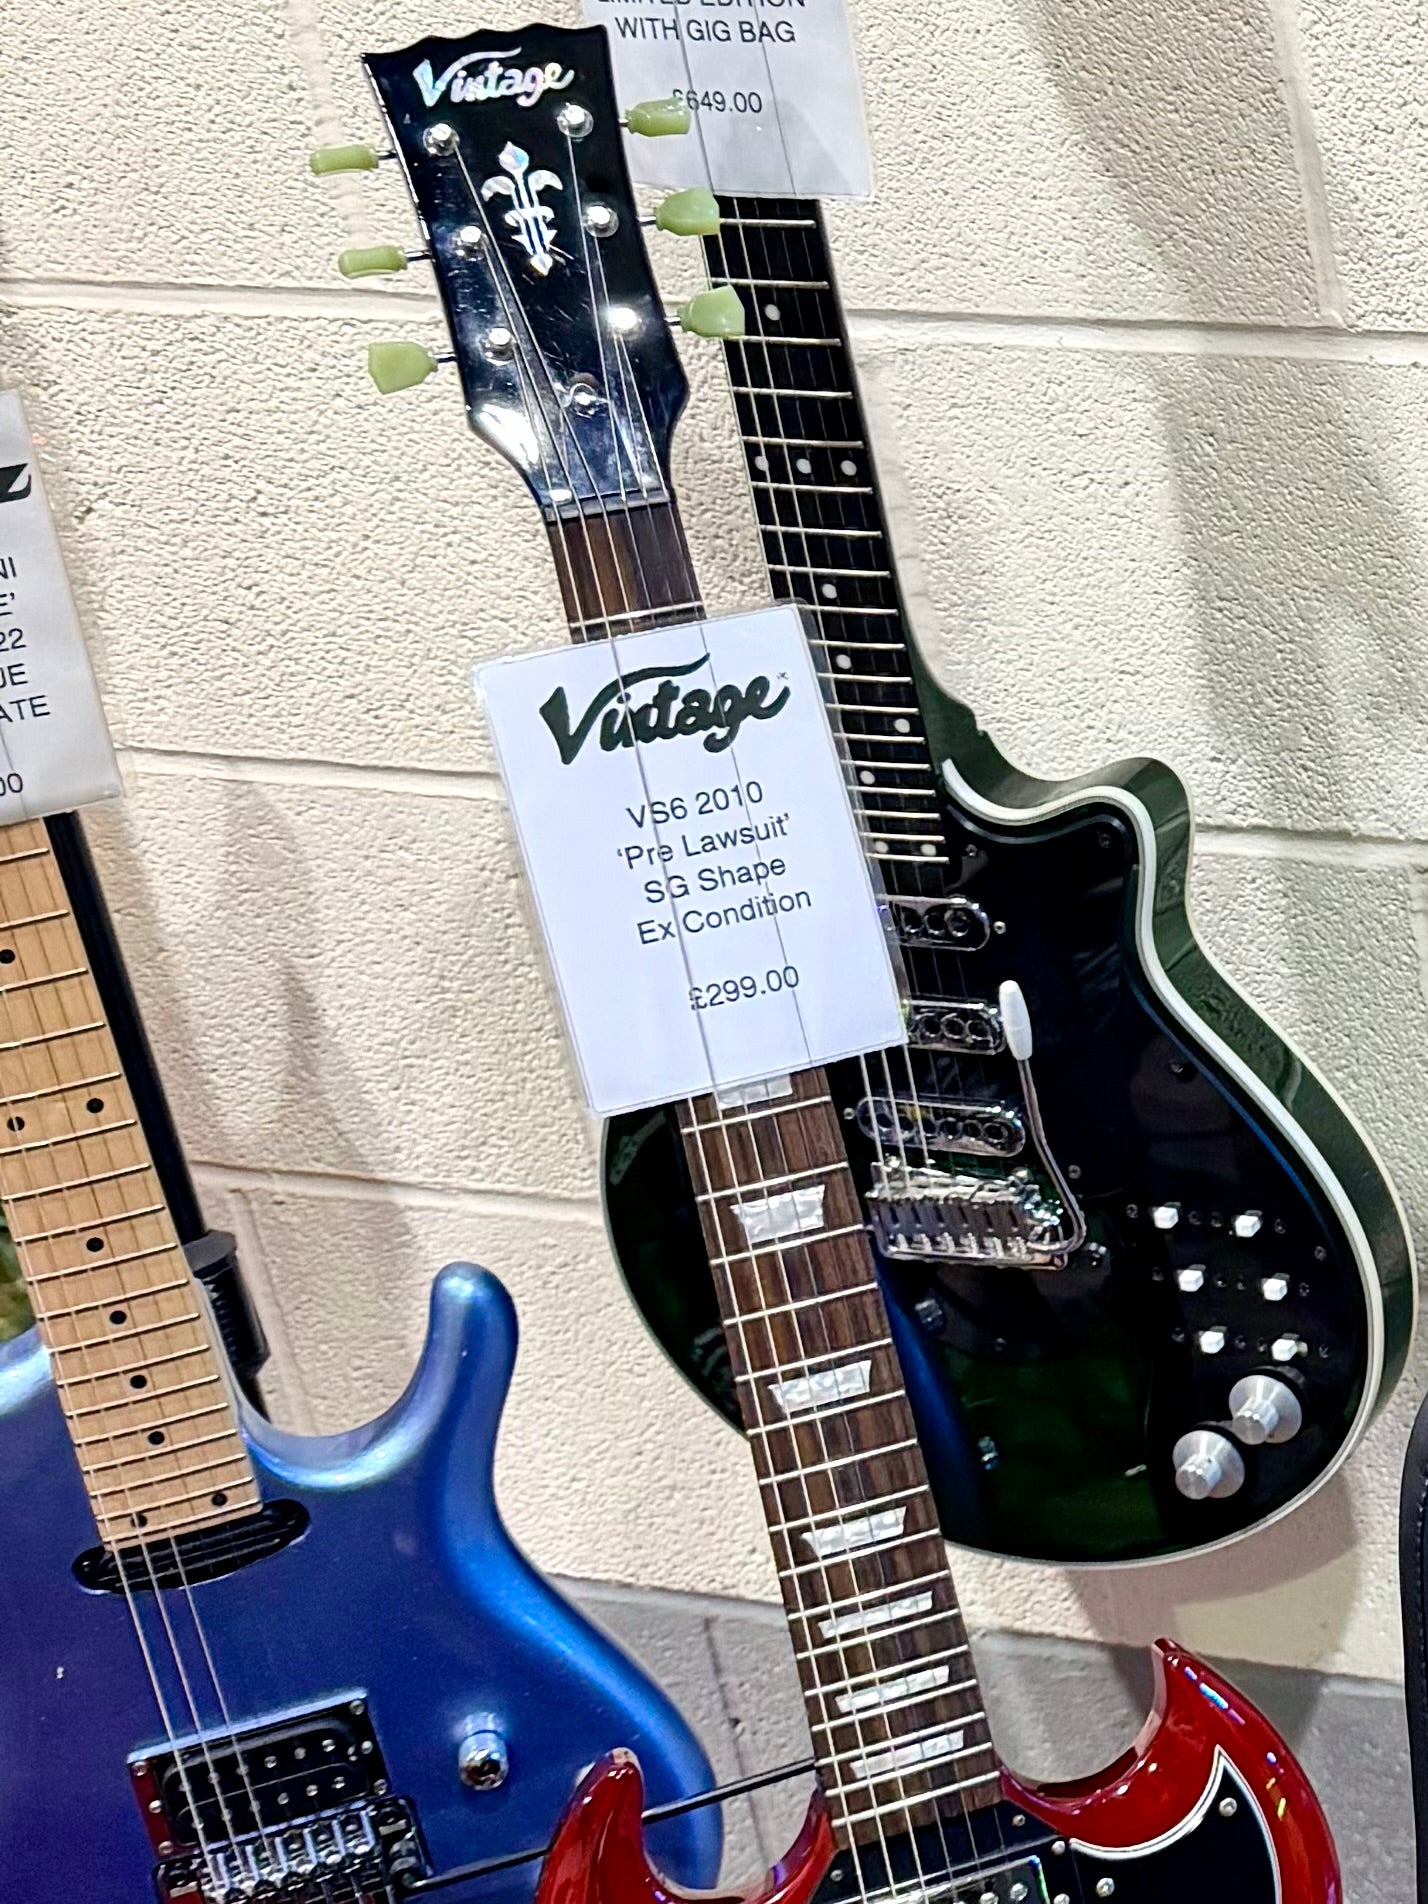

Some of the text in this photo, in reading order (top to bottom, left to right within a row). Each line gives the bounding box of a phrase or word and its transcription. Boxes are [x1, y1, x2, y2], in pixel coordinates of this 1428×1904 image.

[615, 16, 796, 44] WITH GIG BAG
[412, 46, 575, 107] Vintage
[539, 652, 791, 766] Vintage
[626, 781, 764, 830] VS6 2010
[616, 811, 791, 872] ‘Pre Lawsuit’
[644, 857, 787, 905] SG Shape
[637, 889, 812, 945] Ex Condition
[687, 964, 800, 1013] £299.00
